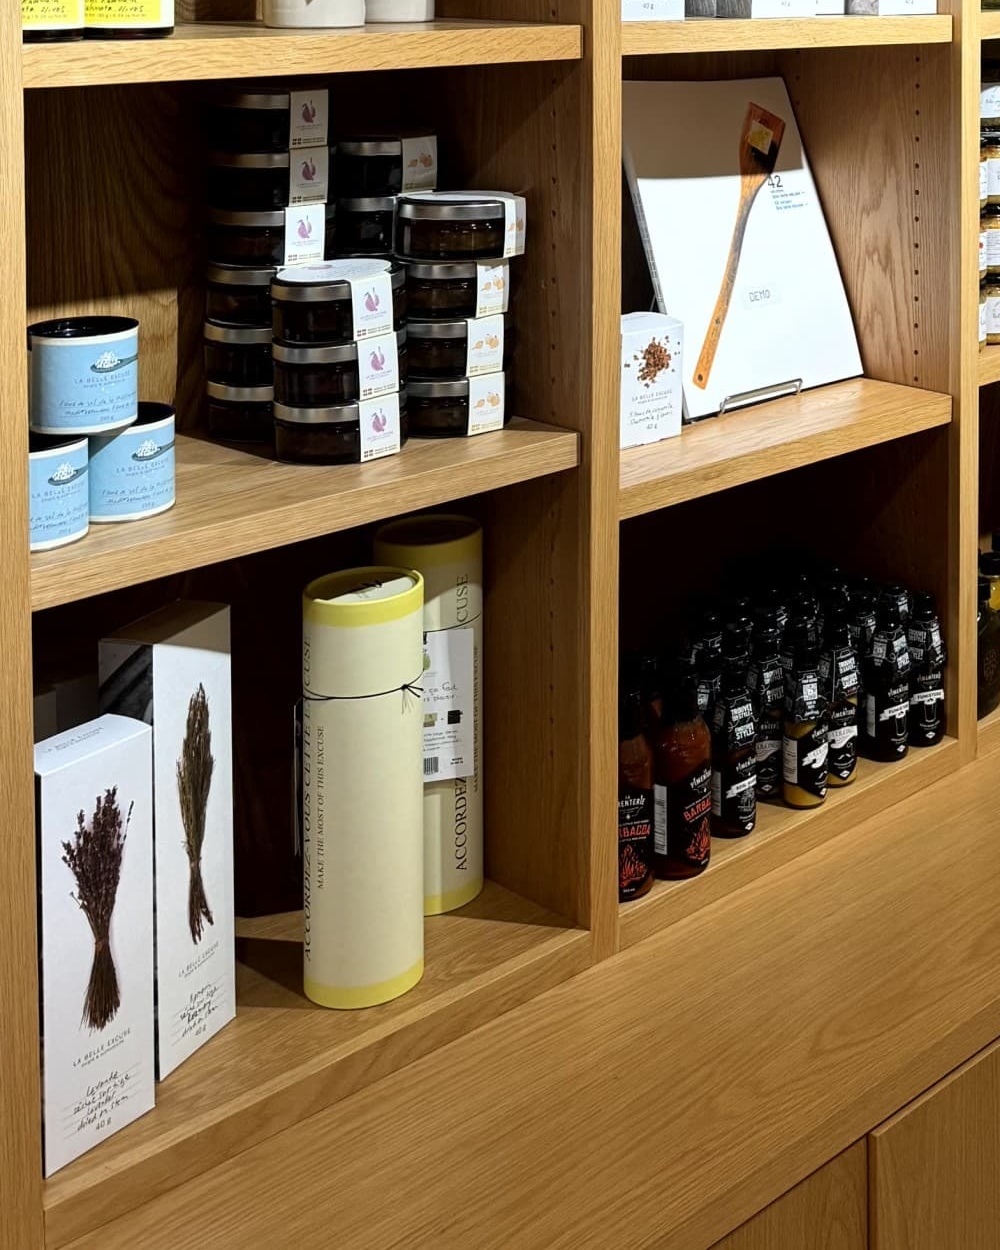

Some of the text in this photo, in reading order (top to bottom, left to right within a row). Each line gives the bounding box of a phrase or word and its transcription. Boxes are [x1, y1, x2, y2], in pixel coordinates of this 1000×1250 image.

[768, 174, 783, 188] 42
[749, 289, 771, 302] DEMO
[316, 725, 326, 890] MAKE THE MOST OF THIS EXCUSE
